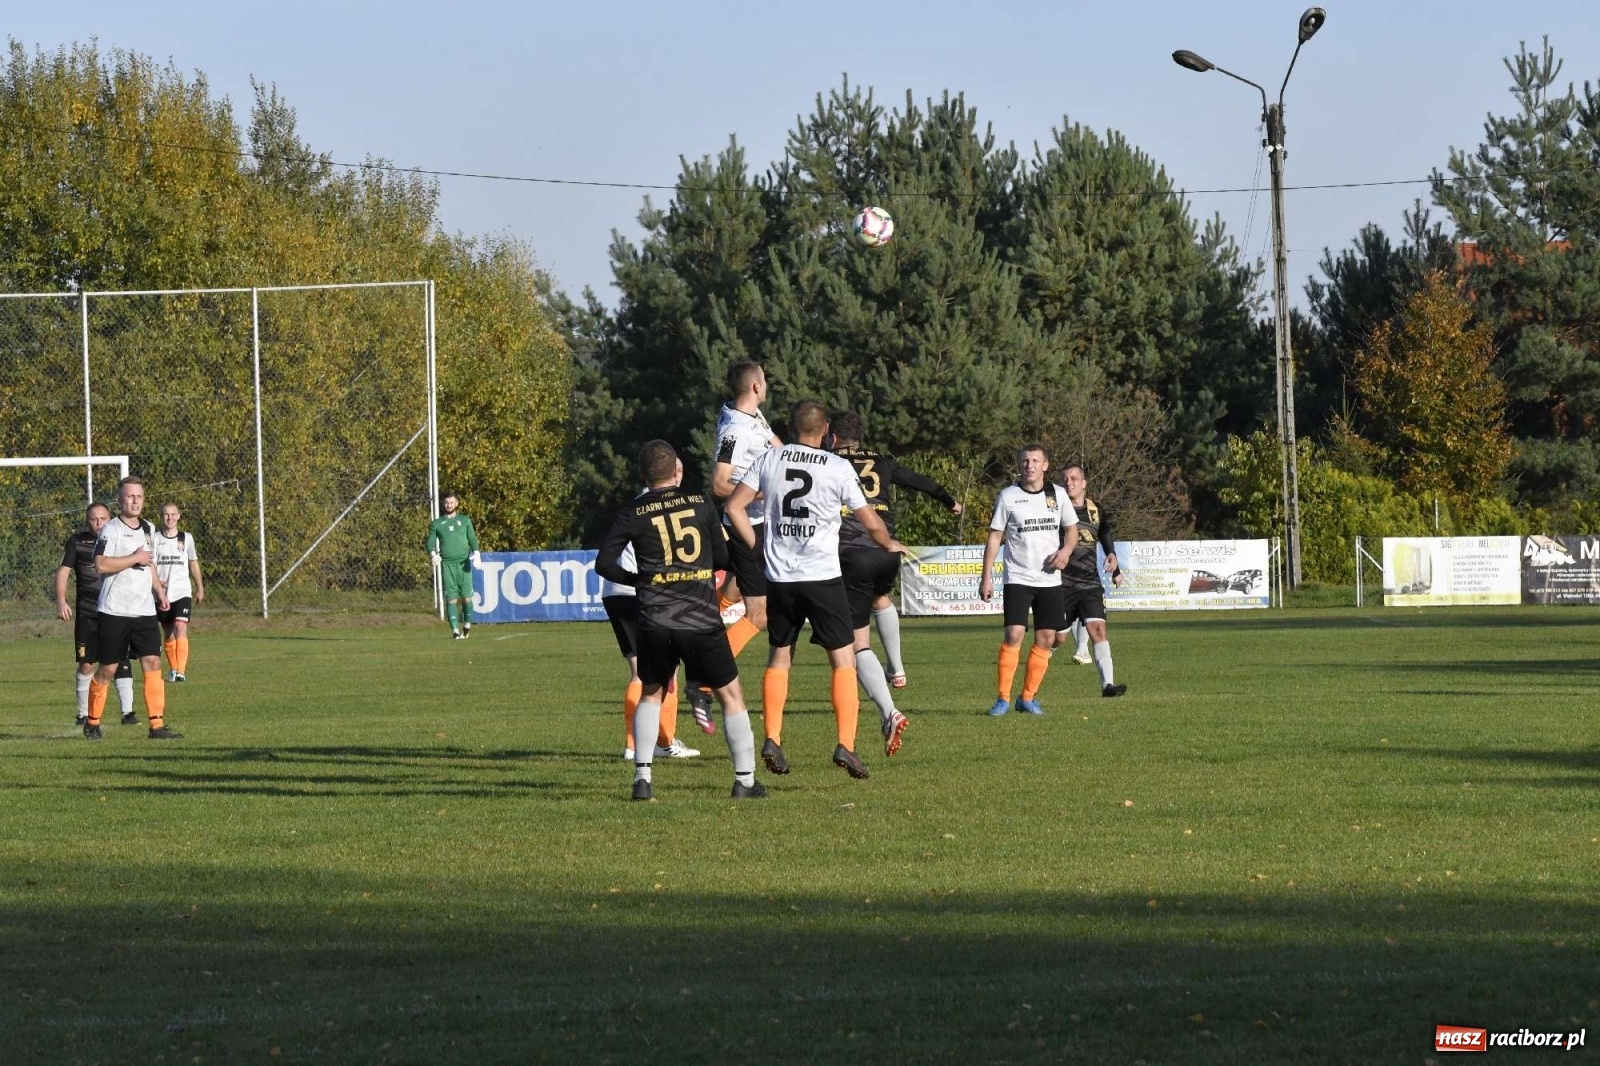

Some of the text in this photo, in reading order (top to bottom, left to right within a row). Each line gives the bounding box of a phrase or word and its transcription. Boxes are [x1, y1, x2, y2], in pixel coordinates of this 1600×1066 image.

[780, 449, 829, 466] PŁOMIEŃ
[782, 468, 813, 519] 2
[635, 502, 663, 516] CZARNI
[664, 497, 687, 509] NOWA
[650, 508, 702, 566] 15
[776, 523, 816, 538] KOBYLA
[945, 548, 985, 560] BRUK
[1129, 543, 1236, 557] Auto Serwis
[914, 591, 955, 600] USŁUGI
[949, 603, 966, 611] 665
[969, 603, 986, 611] 805
